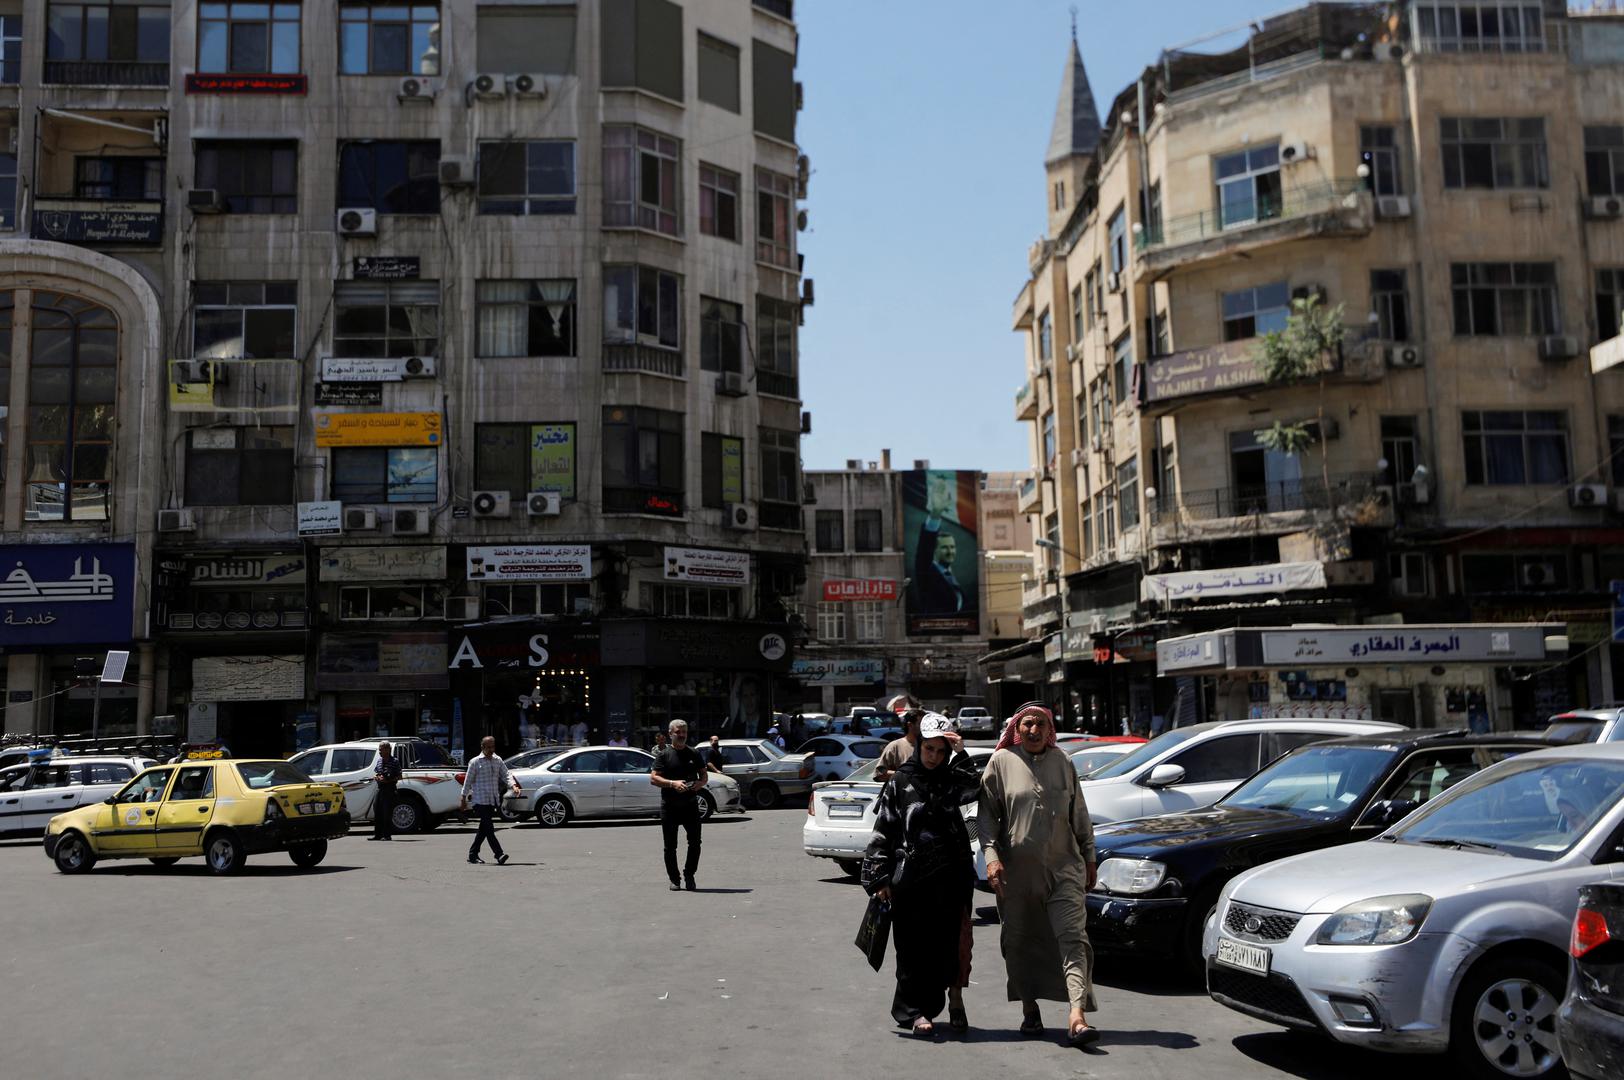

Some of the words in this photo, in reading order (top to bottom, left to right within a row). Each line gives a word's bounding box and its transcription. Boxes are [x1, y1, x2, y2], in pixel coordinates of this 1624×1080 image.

[1151, 350, 1211, 383] الشرق
[1156, 377, 1208, 398] NAJMET
[533, 426, 569, 451] مختبر
[192, 561, 263, 580] الشام
[872, 580, 893, 596] دار
[1173, 572, 1284, 596] القدموس
[4, 609, 57, 625] خدمة
[448, 634, 484, 669] A
[528, 633, 550, 667] S
[1349, 635, 1404, 658] العقاري
[1409, 635, 1460, 655] المصرف
